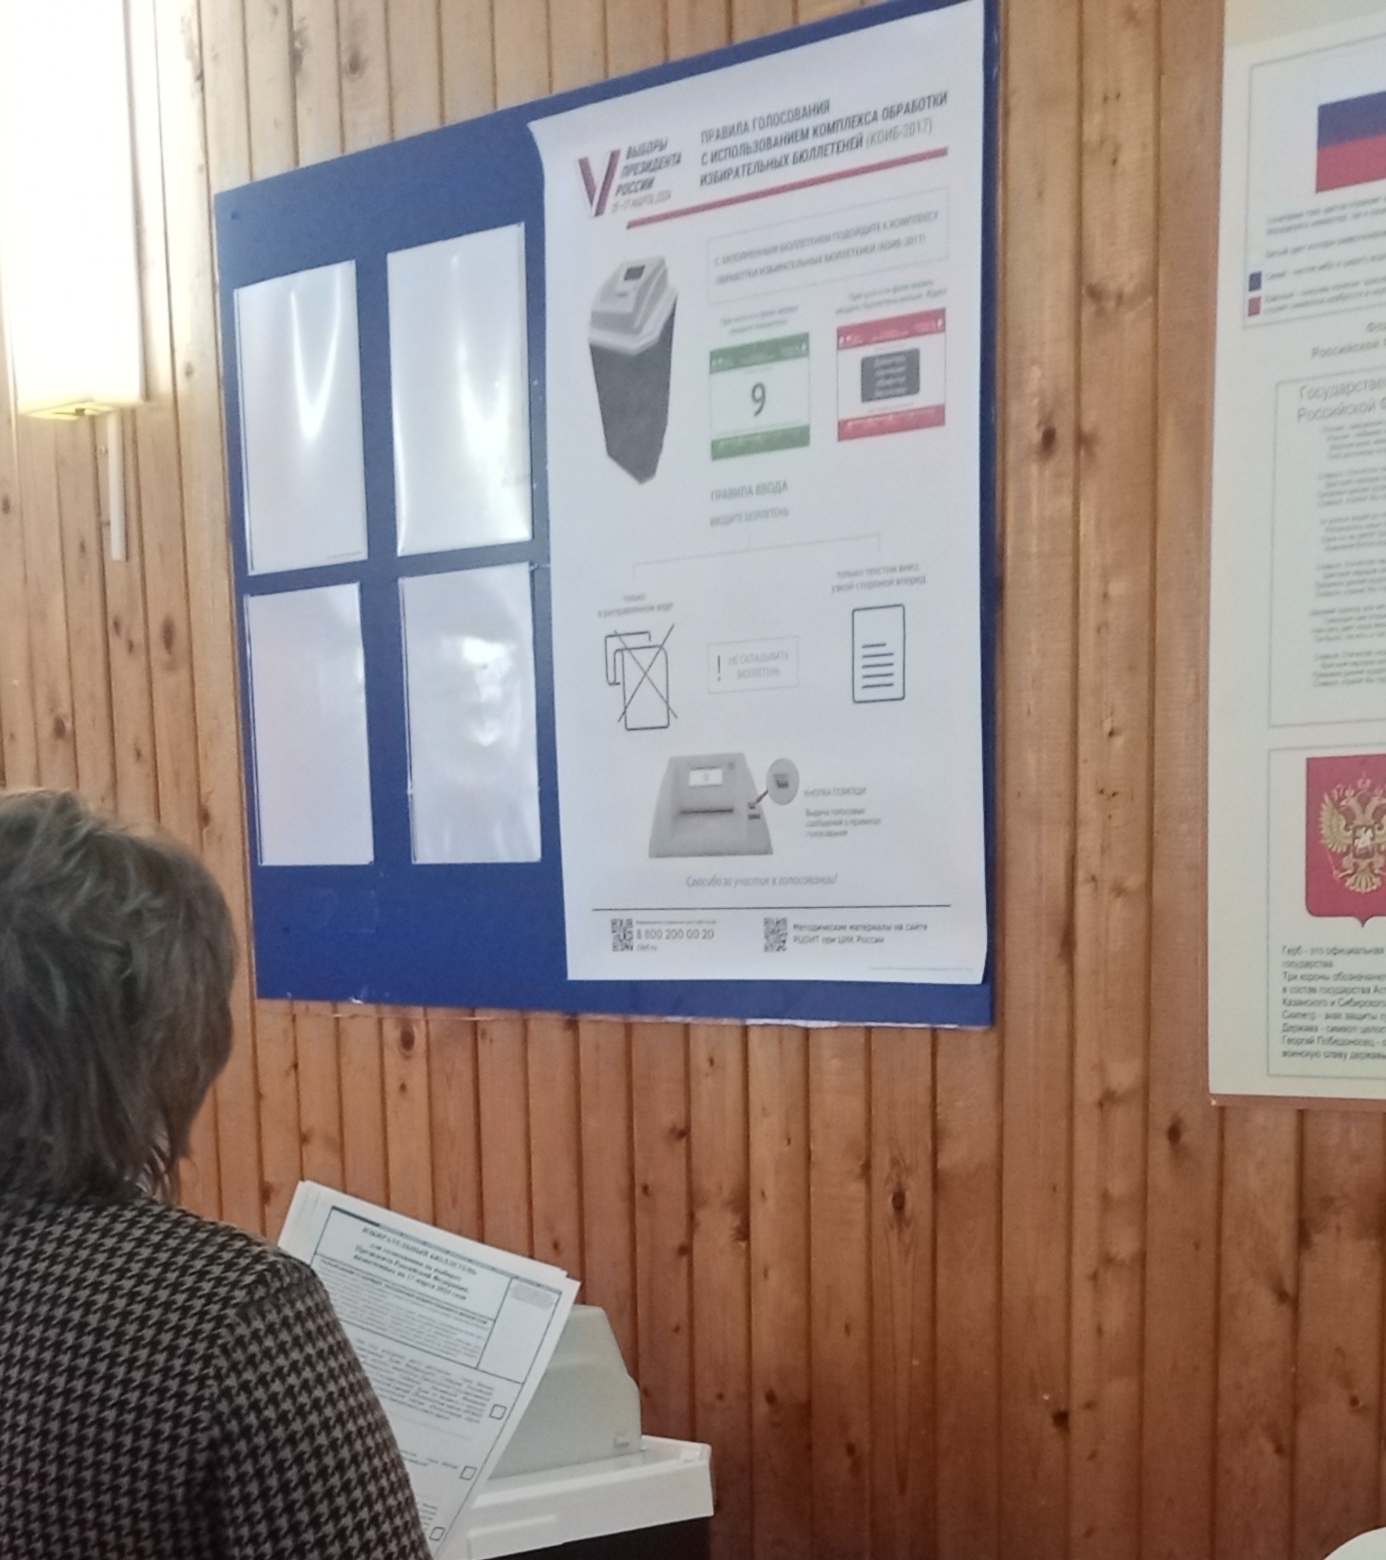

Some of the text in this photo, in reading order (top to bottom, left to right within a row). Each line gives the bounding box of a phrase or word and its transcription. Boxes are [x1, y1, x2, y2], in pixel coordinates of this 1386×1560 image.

[700, 99, 831, 145] ПРАВИЛА ГОЛОСОВАНИЯ
[701, 91, 949, 166] С ИСПОЛЬЗОВАНИЕМ КОМПЛЕКСА ОБРАБОТКИ
[700, 155, 789, 187] ИЗБИРАТЕЛЬНЫХ
[791, 133, 863, 165] БЮЛЛЕТЕНЕЙ
[751, 382, 766, 418] 9
[1297, 400, 1376, 423] Российской
[711, 480, 789, 502] ПРАВИЛА ВВОДА
[645, 928, 663, 940] 800
[665, 928, 684, 940] 200
[686, 928, 700, 940] 00
[702, 928, 715, 940] 20
